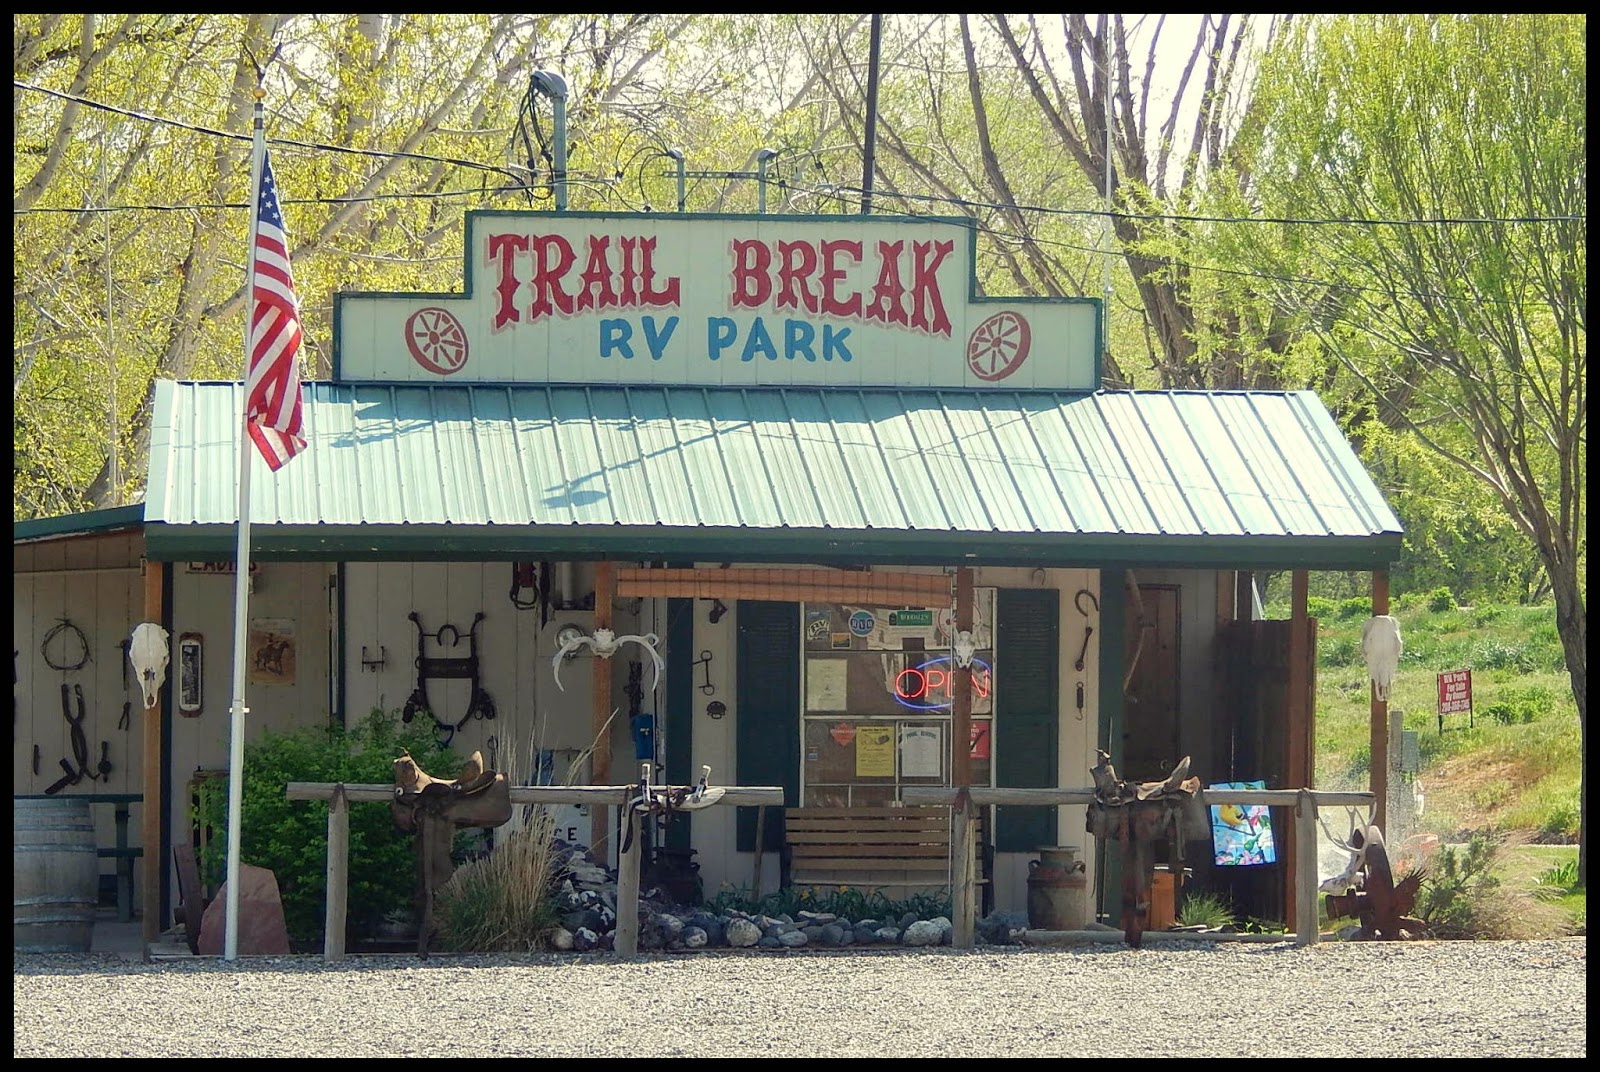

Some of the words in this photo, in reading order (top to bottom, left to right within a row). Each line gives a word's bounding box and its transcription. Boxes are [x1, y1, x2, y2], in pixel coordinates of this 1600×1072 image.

[487, 233, 681, 329] TRAIL
[729, 238, 955, 337] BREAK
[600, 316, 679, 361] RV
[708, 317, 853, 364] PARK
